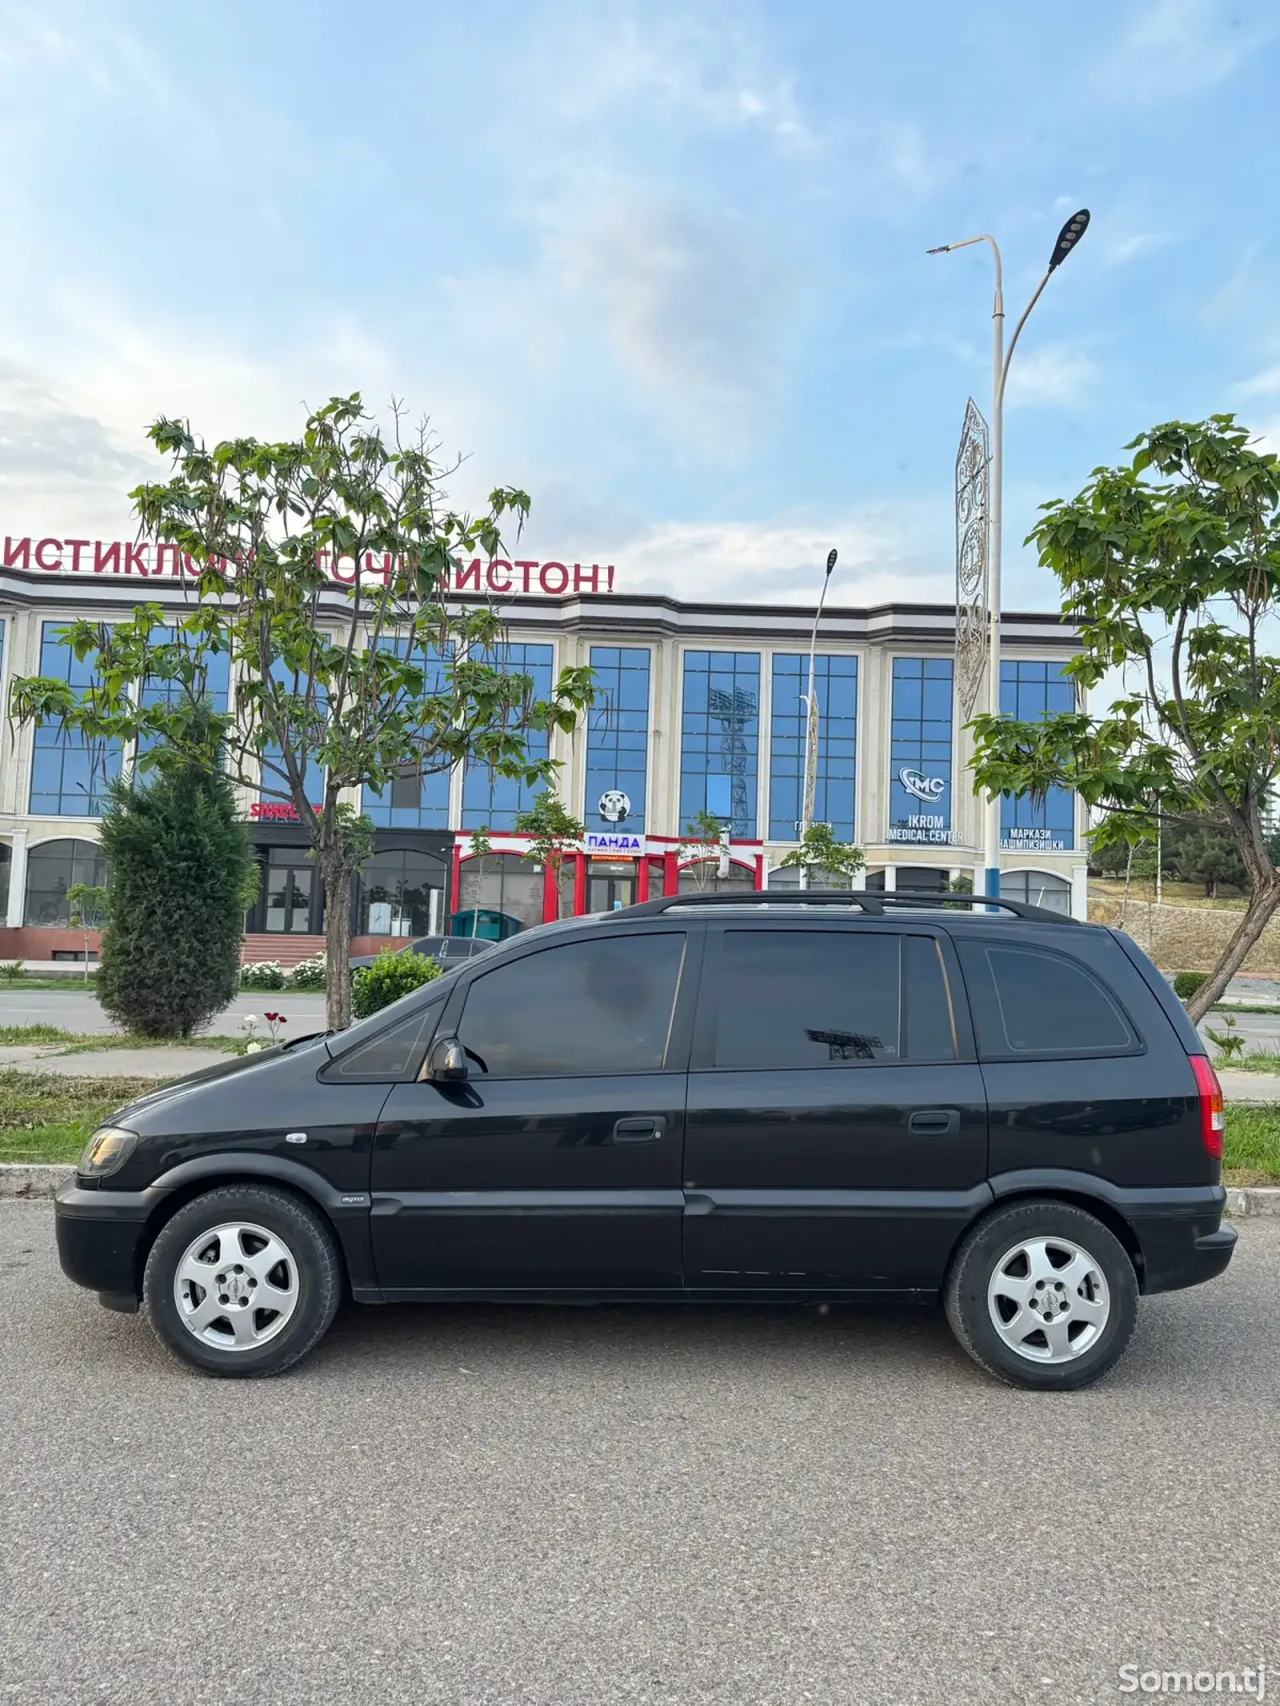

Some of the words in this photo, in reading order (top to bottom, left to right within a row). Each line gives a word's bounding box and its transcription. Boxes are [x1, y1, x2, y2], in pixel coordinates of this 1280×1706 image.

[908, 814, 944, 828] IKROM
[888, 829, 928, 841] MEDICAL
[929, 830, 964, 844] CENTER
[1010, 828, 1052, 839] МАРКАЗИ
[588, 836, 640, 848] ПАНДА
